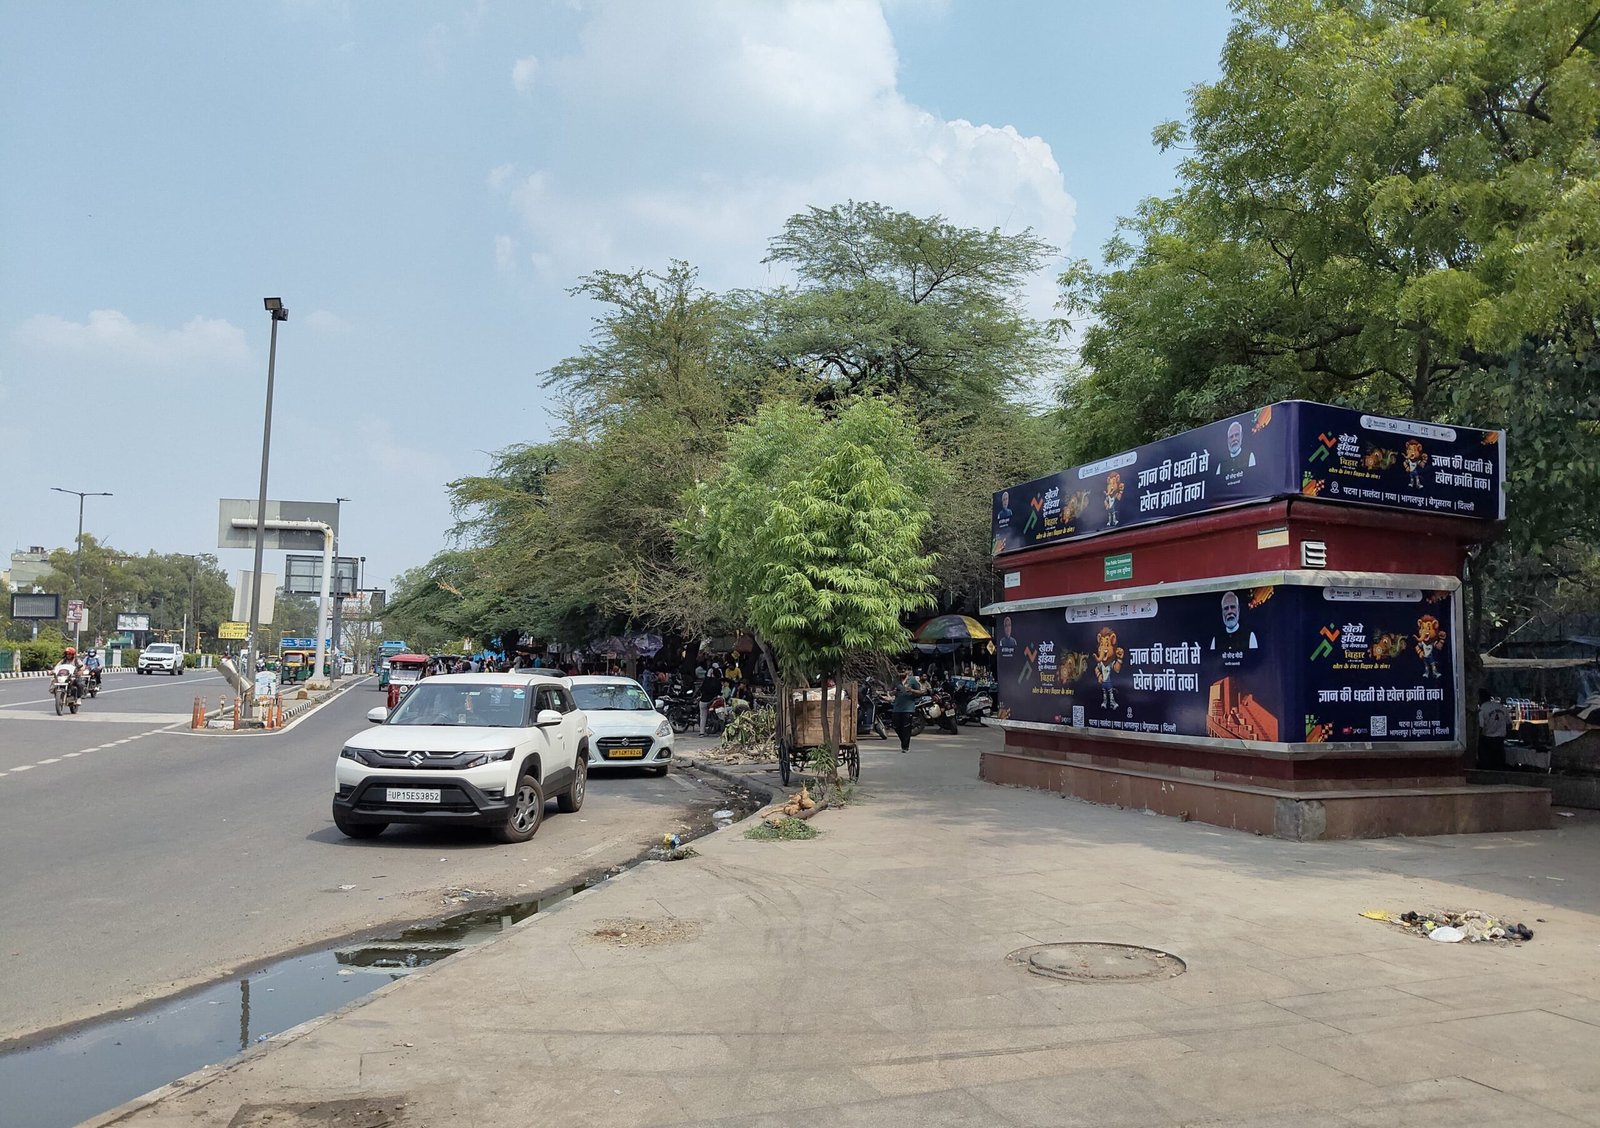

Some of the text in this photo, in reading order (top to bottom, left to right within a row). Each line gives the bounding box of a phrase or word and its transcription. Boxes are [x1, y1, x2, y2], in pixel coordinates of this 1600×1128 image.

[1138, 467, 1158, 488] ज्ञान
[1159, 459, 1172, 482] की
[1174, 452, 1198, 478] धरती
[1199, 449, 1210, 472] से
[1340, 457, 1358, 466] बिहार
[1431, 455, 1493, 474] ज्ञान की धरती से
[1435, 469, 1453, 485] खेल
[1454, 472, 1473, 488] क्रांति
[1140, 490, 1160, 512] खेल
[1161, 482, 1183, 509] क्रांति
[1343, 487, 1358, 495] पटना
[1385, 492, 1396, 500] गया
[1342, 623, 1364, 633] खेलो
[1341, 633, 1366, 644] इंडिया
[1129, 642, 1201, 665] ज्ञान की धरती से
[1345, 650, 1365, 660] बिहार
[1133, 669, 1153, 690] खेल
[1154, 669, 1176, 691] क्रांति
[1318, 690, 1338, 702] ज्ञान
[1340, 687, 1352, 702] की
[1354, 687, 1375, 702] धरती
[1376, 686, 1385, 701] से
[1386, 686, 1404, 701] खेल
[1406, 686, 1425, 702] क्रांति
[392, 791, 439, 801] UP15ES3852
